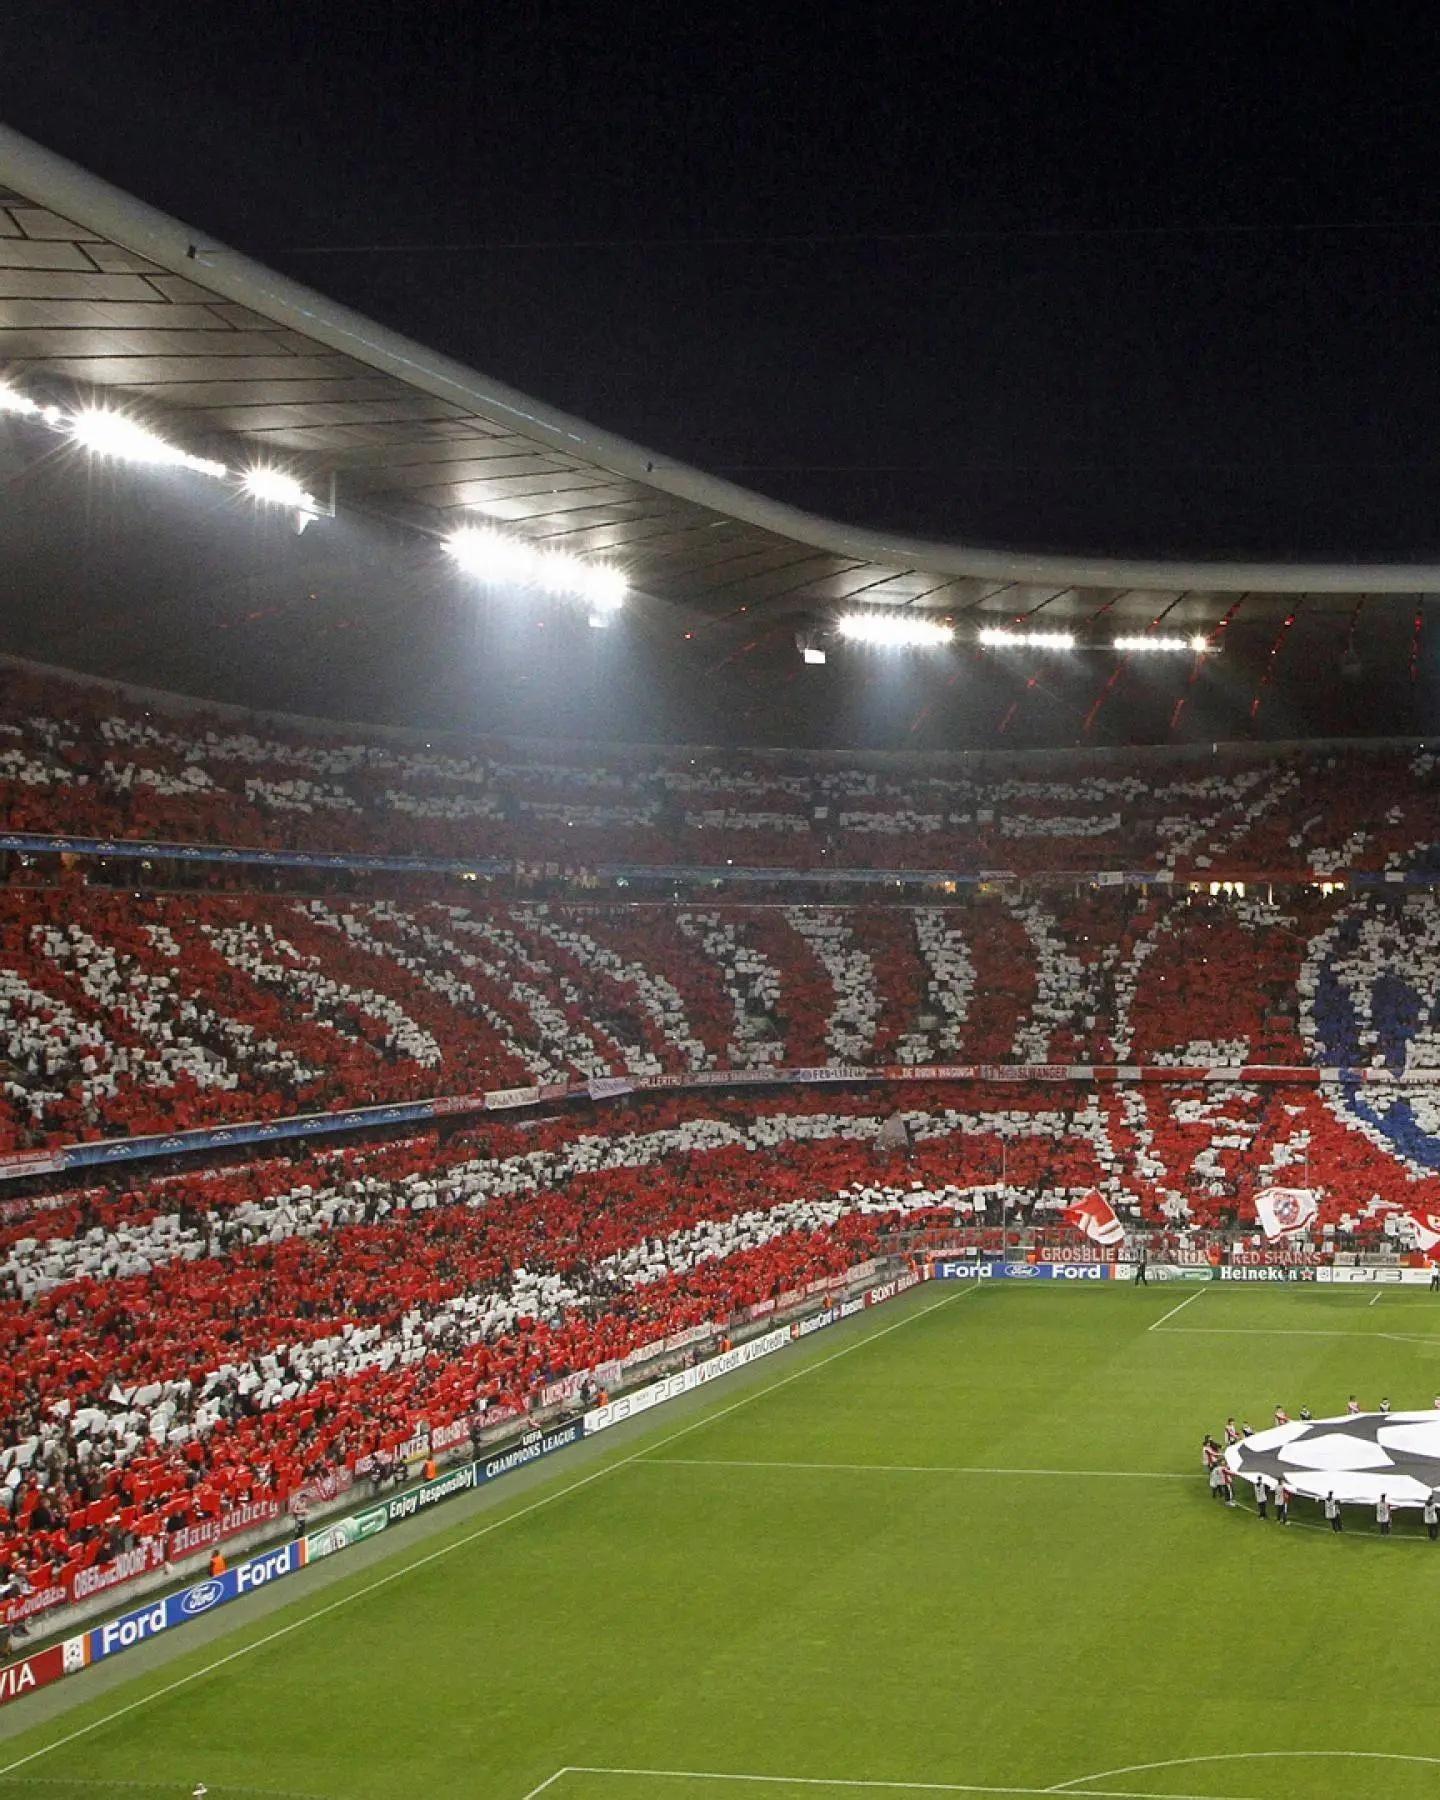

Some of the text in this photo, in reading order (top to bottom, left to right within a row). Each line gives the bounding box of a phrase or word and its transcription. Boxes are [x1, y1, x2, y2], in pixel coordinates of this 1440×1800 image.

[943, 1264, 993, 1277] Ford
[1052, 1265, 1100, 1278] Ford
[1232, 1251, 1321, 1266] RED SHARKS
[1221, 1267, 1297, 1280] Heineken
[871, 1282, 896, 1304] SONY
[752, 1332, 783, 1358] UniCredit
[707, 1352, 739, 1378] UniCredit
[653, 1375, 686, 1401] PS3
[598, 1401, 631, 1428] PS3
[522, 1429, 542, 1446] UEFA
[486, 1427, 576, 1478] CHAMPIONS LEAGUE
[389, 1466, 473, 1519] Enjoy Responsibly
[237, 1546, 291, 1593] Ford
[103, 1600, 167, 1654] Ford
